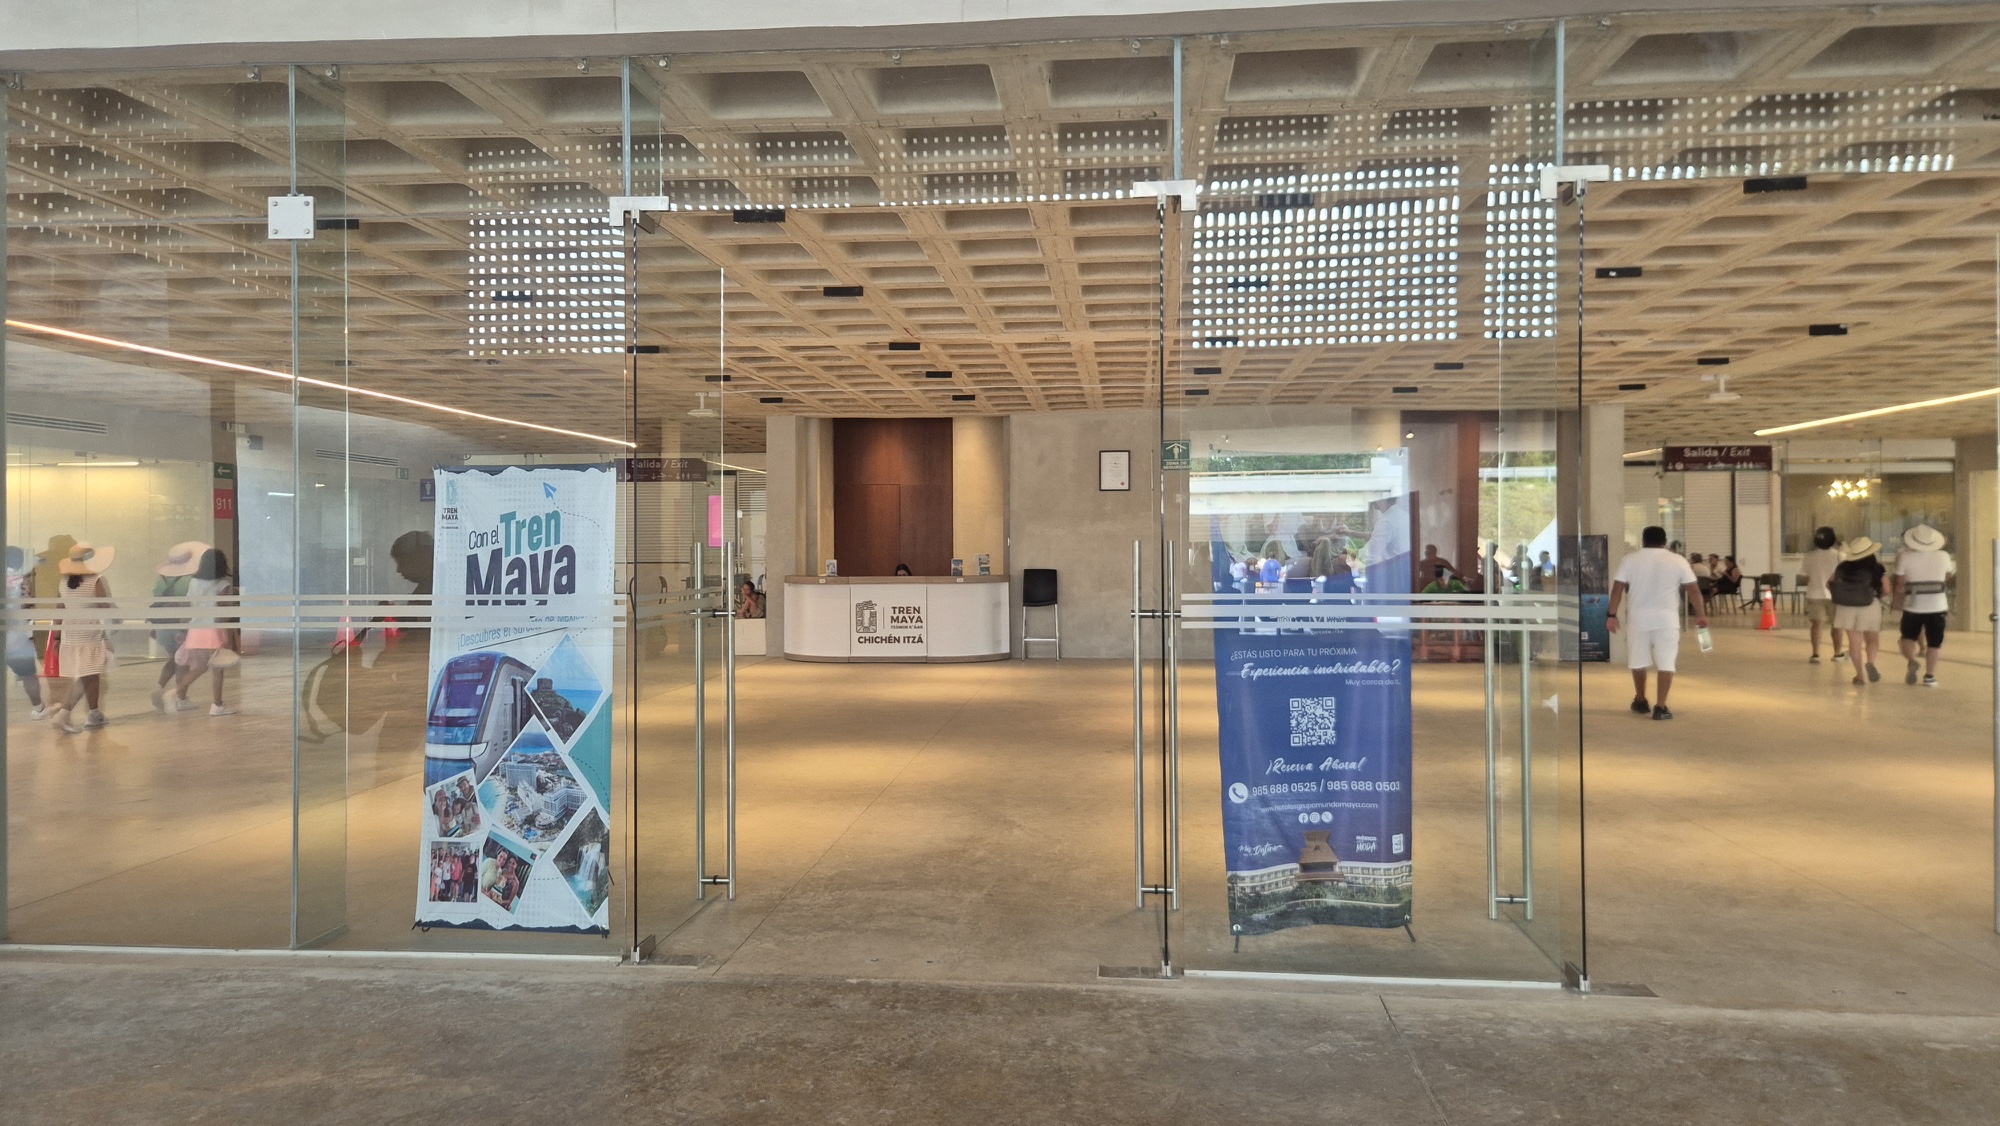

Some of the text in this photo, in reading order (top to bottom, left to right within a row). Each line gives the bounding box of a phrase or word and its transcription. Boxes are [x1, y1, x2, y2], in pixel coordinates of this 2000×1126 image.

[1683, 446, 1719, 457] Salida
[1729, 446, 1752, 457] Exit
[631, 459, 661, 469] Salida
[670, 459, 689, 469] Exit
[216, 497, 232, 510] 911
[469, 510, 562, 558] Con el Tren
[891, 606, 921, 615] TREN
[890, 615, 924, 624] MAYA
[857, 633, 924, 644] CHICHÉN ITZÁ
[1230, 645, 1358, 661] ¿ESTÁS LISTO PARA TU PRÓXIMA
[1240, 658, 1401, 681] Experiencia inolvidable?
[1345, 679, 1360, 687] Muy
[1318, 756, 1367, 772] Ahora!
[1252, 778, 1400, 796] 985 688 0525 / 985 688 0503
